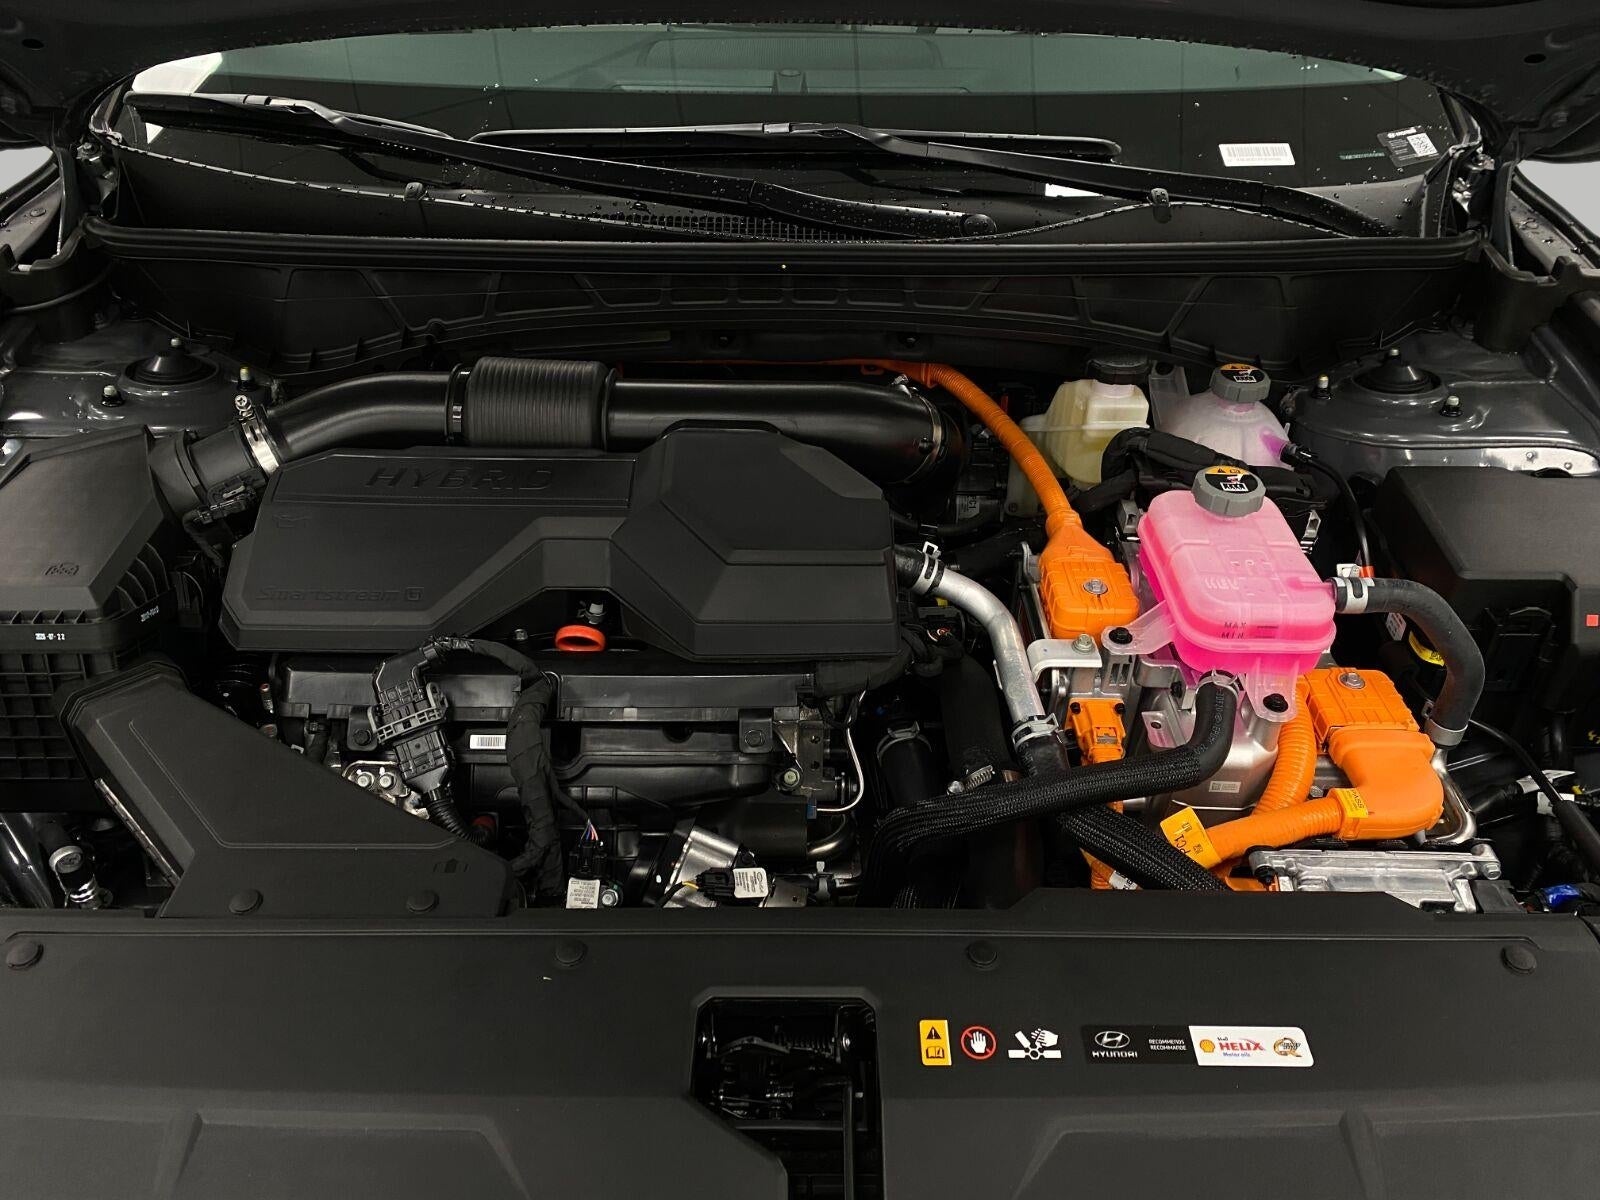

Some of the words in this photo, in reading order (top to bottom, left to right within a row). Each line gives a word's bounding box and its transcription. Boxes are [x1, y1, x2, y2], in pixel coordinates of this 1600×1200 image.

[1223, 621, 1247, 629] MAX
[1221, 631, 1245, 639] MIN
[1219, 1042, 1264, 1051] HELIX
[1091, 1050, 1138, 1058] HYUNDAI
